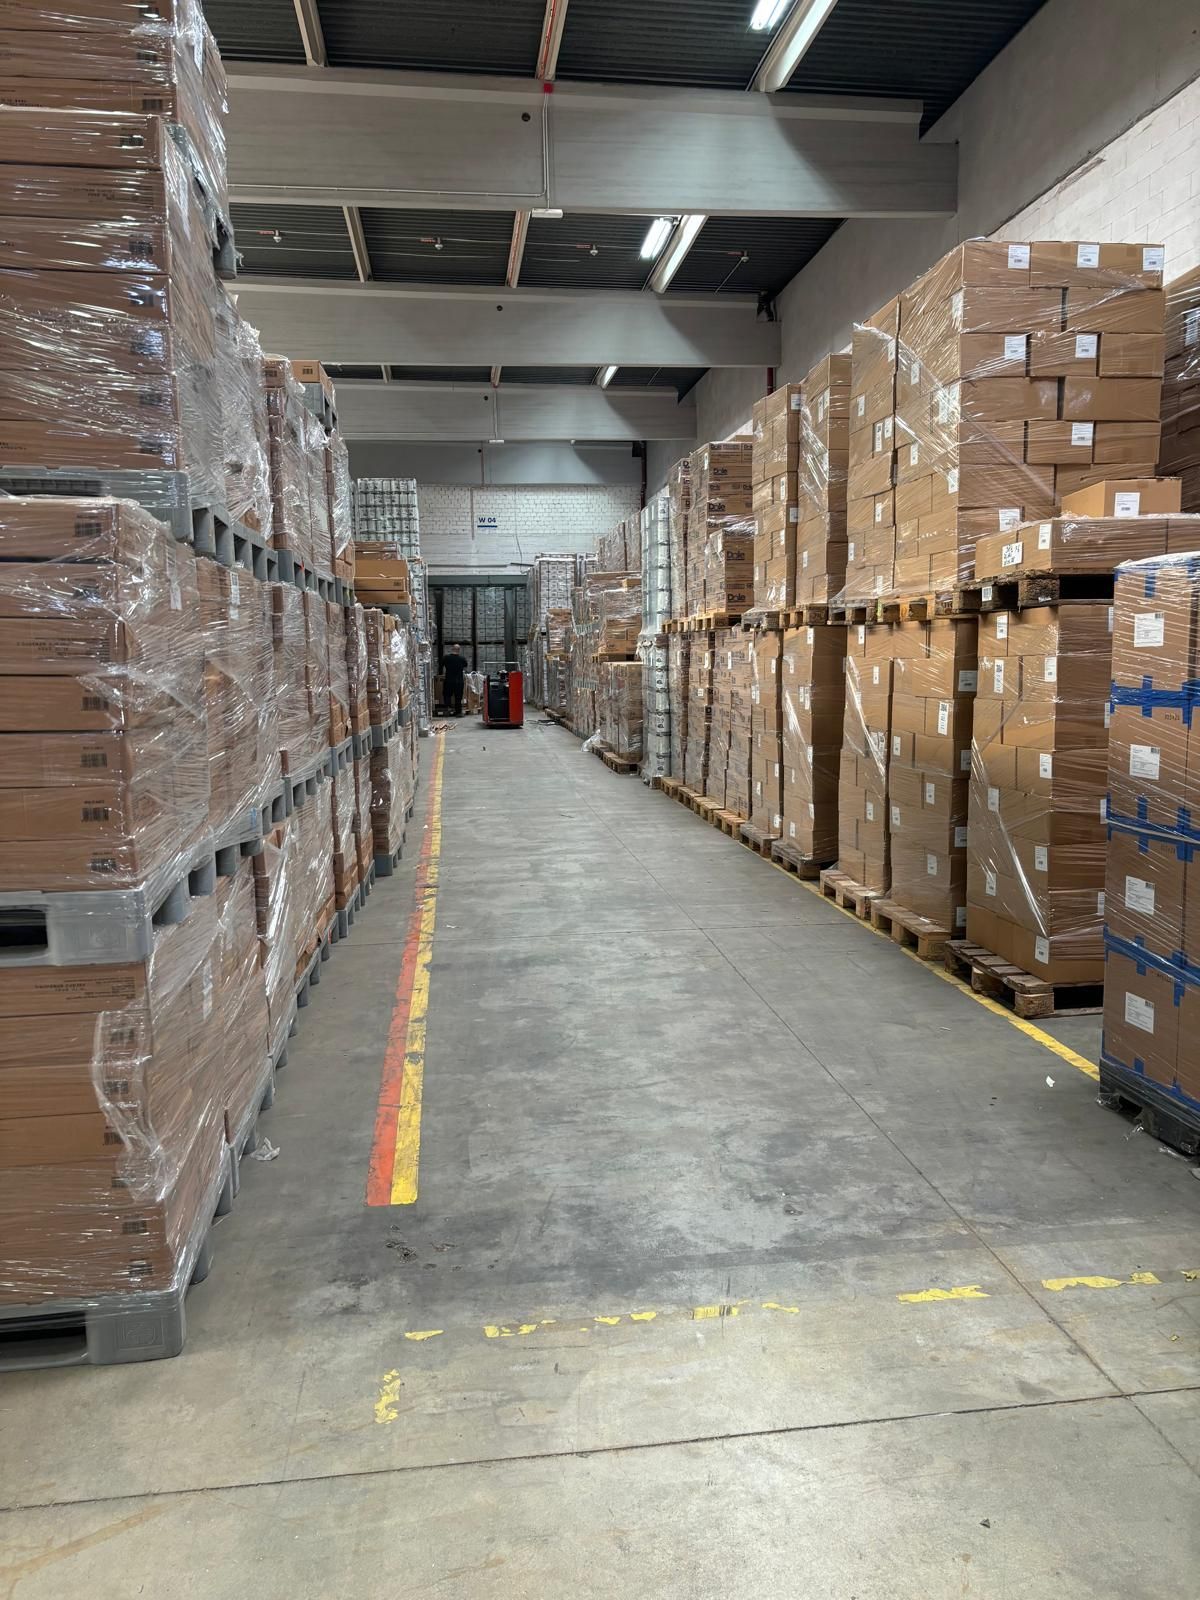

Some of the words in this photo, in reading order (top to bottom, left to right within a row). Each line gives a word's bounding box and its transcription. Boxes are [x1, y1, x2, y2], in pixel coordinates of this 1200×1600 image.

[708, 502, 726, 511] Dole
[726, 550, 745, 560] Dole
[727, 593, 746, 602] Dole
